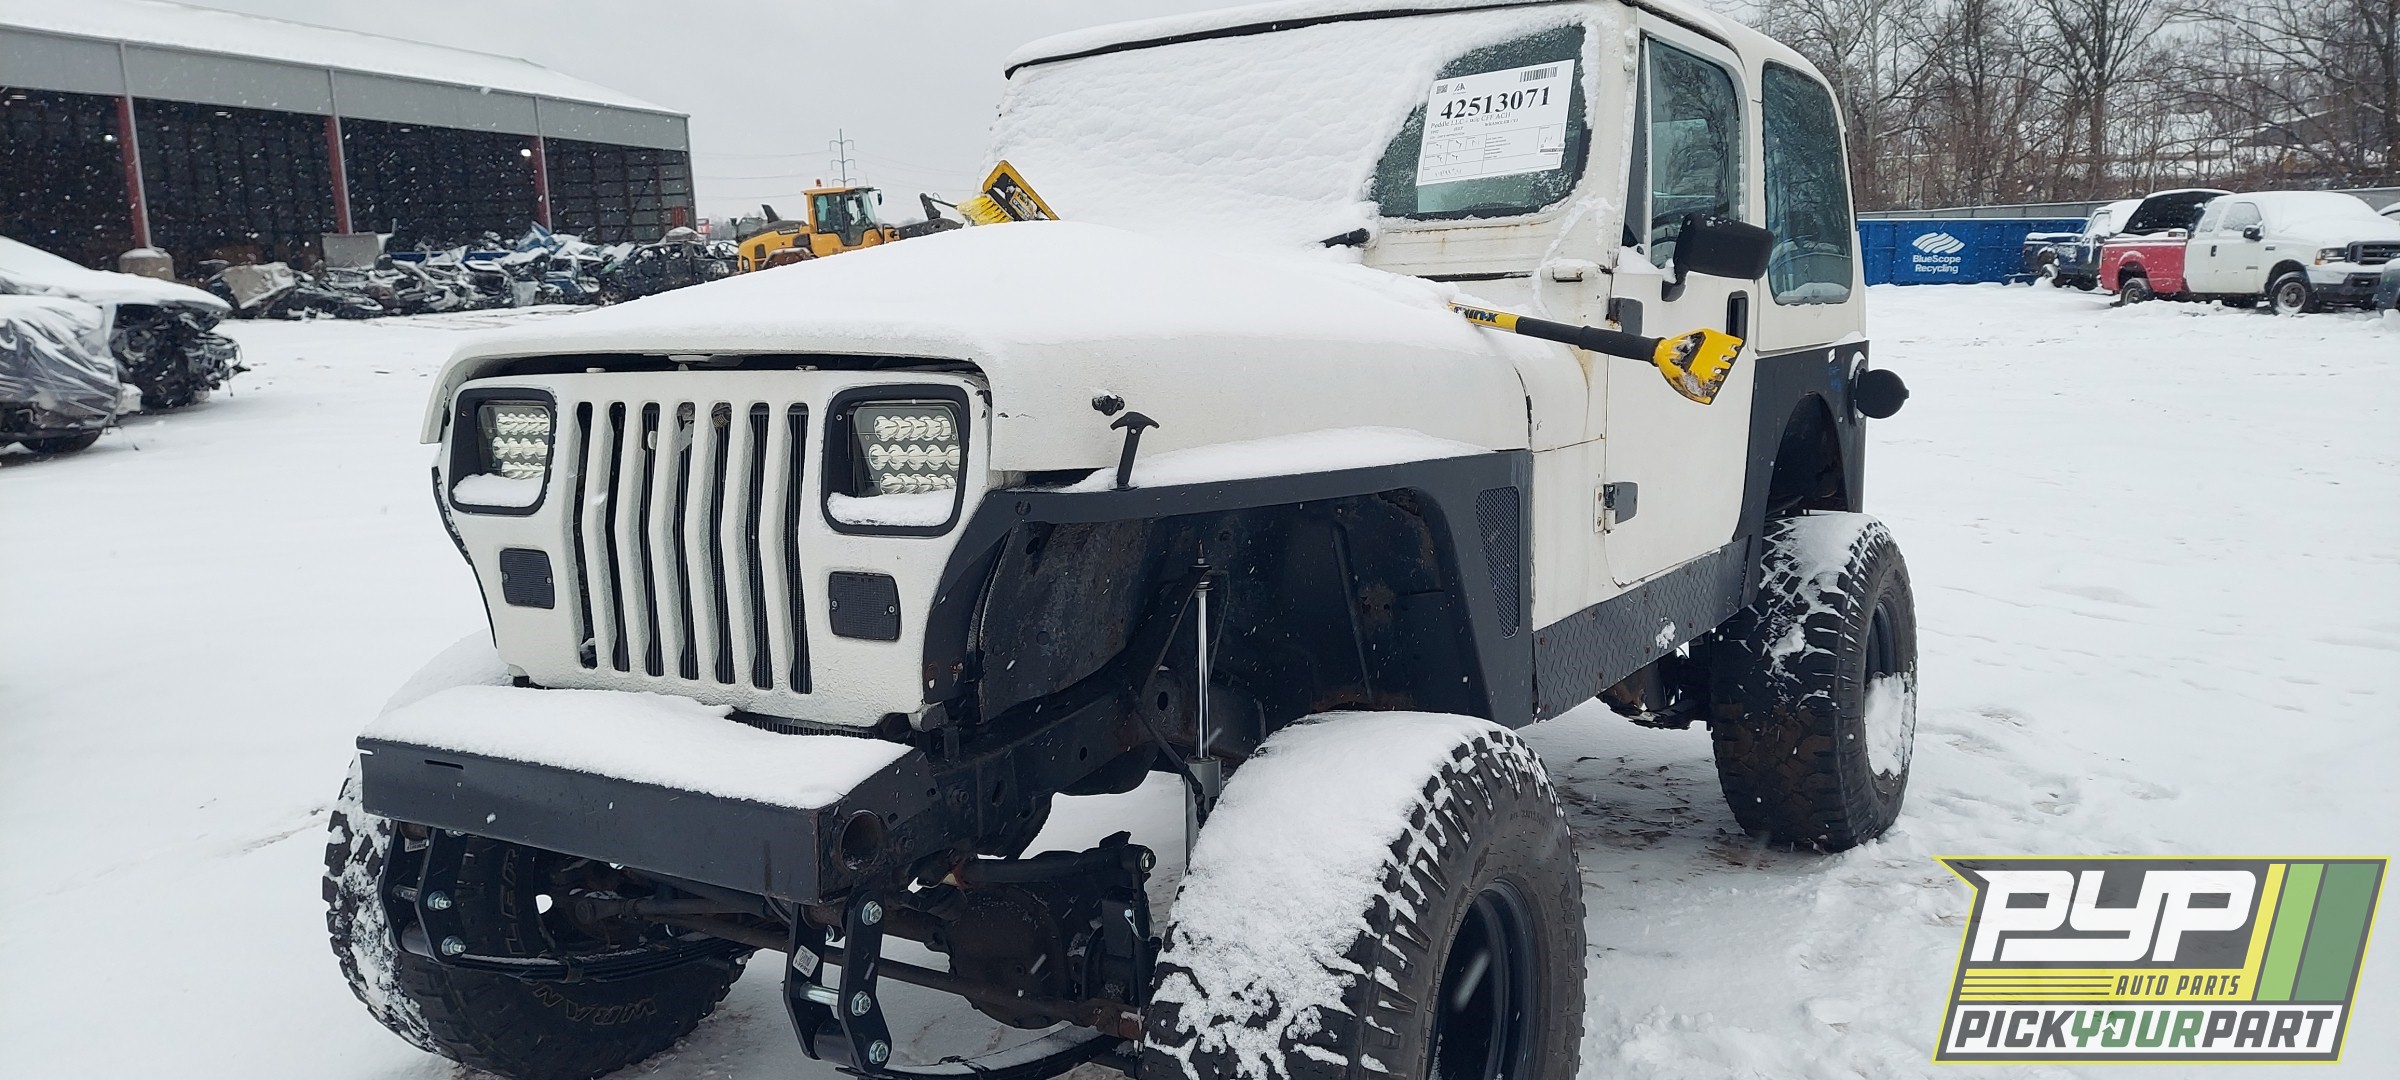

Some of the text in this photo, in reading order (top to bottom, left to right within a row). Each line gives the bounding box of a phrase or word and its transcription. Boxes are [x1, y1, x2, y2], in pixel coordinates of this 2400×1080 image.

[1440, 86, 1550, 120] 42513071
[1912, 254, 1961, 264] BlueScope
[1915, 264, 1959, 274] Recycling
